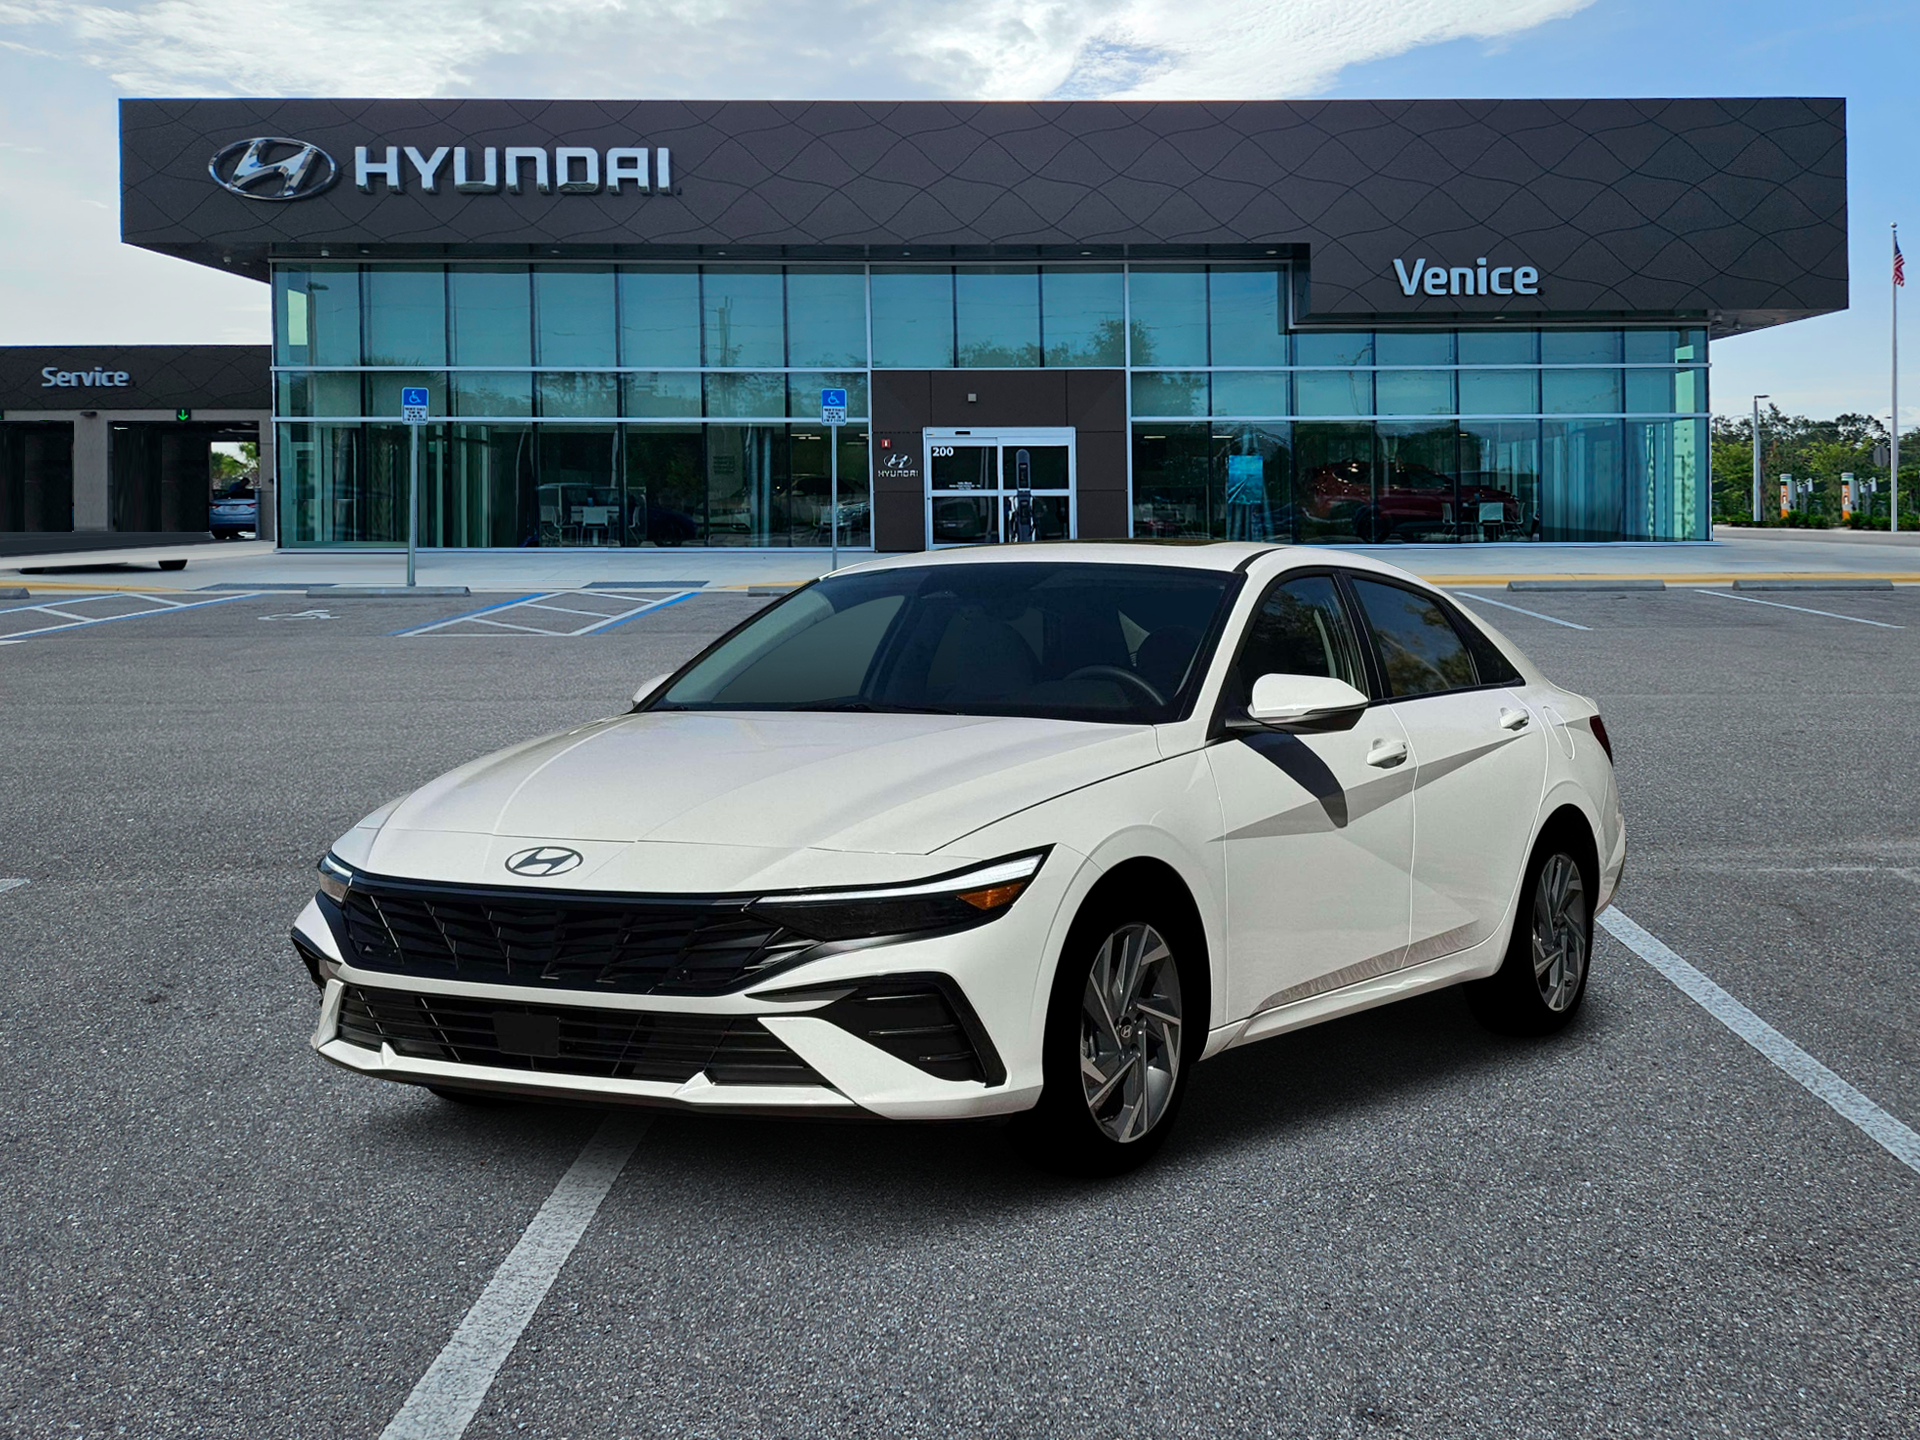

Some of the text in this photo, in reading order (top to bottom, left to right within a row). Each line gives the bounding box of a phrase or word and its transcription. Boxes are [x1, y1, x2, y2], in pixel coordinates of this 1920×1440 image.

[354, 146, 670, 194] HYUNDAI
[1393, 257, 1539, 296] Venice
[41, 366, 130, 388] Service
[932, 446, 954, 457] 200
[878, 469, 919, 478] HYUNDAI
